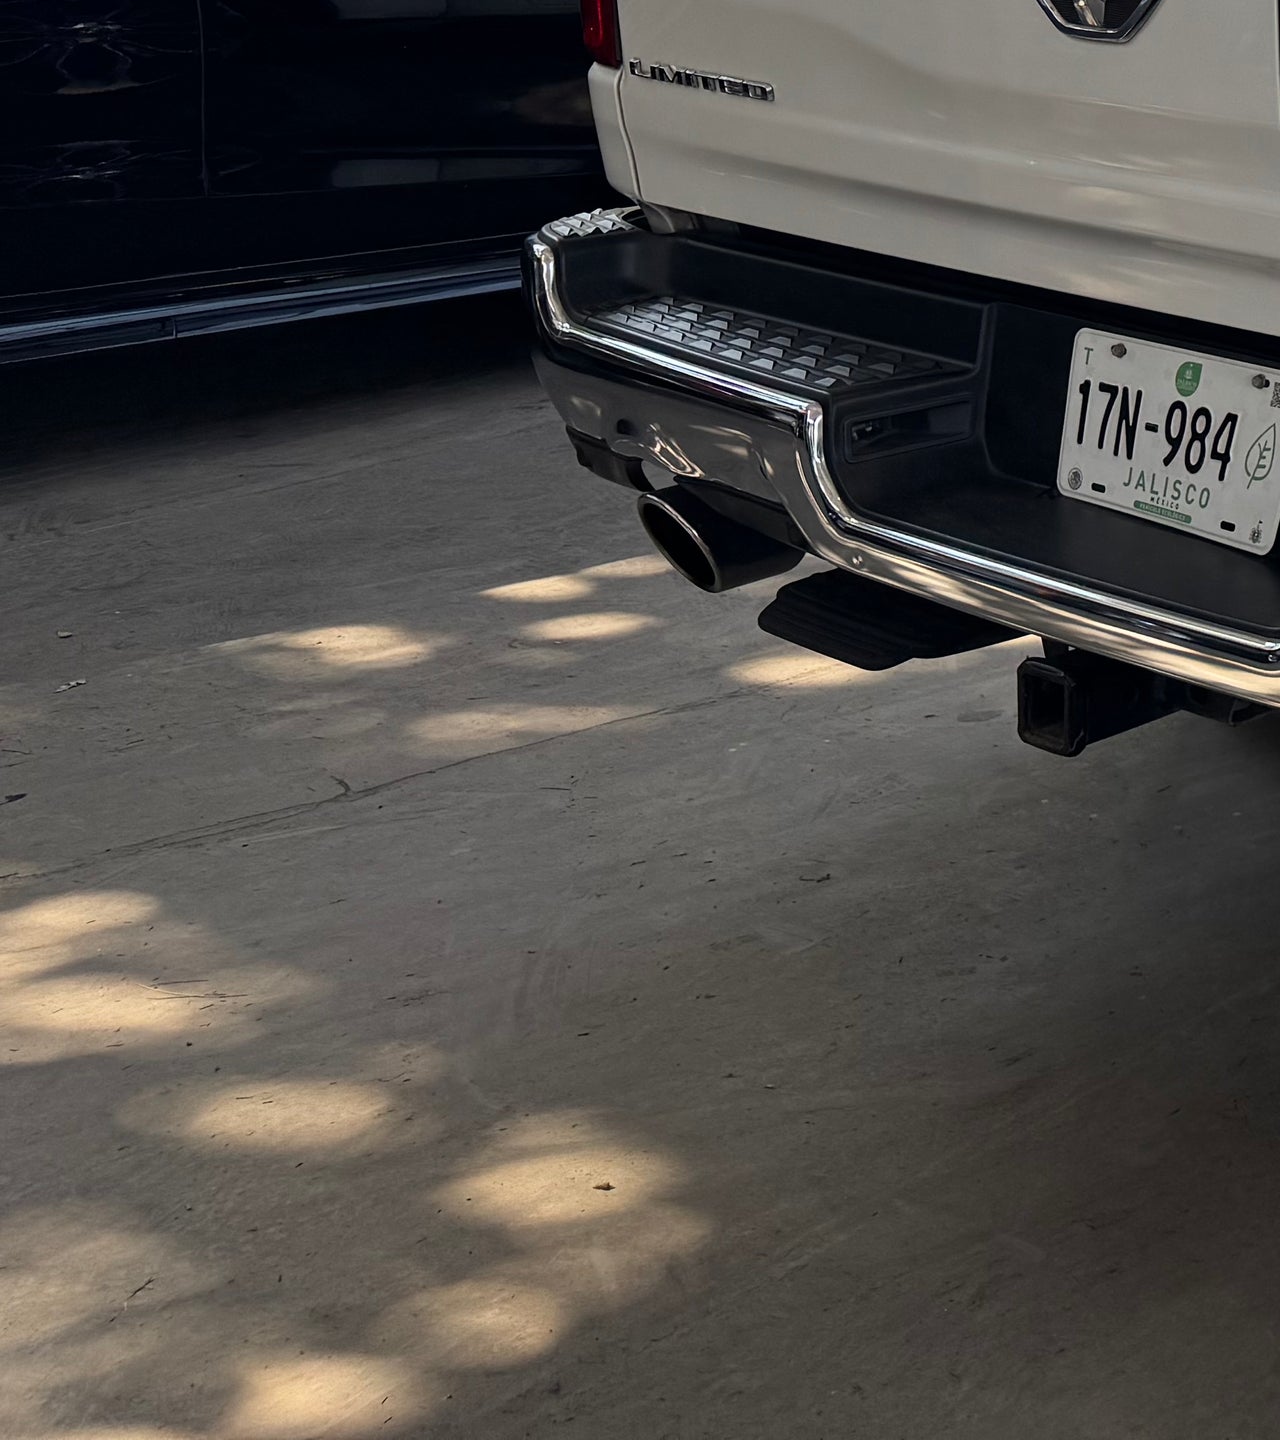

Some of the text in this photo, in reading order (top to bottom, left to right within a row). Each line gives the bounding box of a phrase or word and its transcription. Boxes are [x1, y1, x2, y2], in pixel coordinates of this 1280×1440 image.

[629, 56, 776, 102] LIMITED
[1084, 346, 1094, 366] T
[1076, 378, 1239, 482] 17N-984
[1122, 466, 1211, 509] JALISCO
